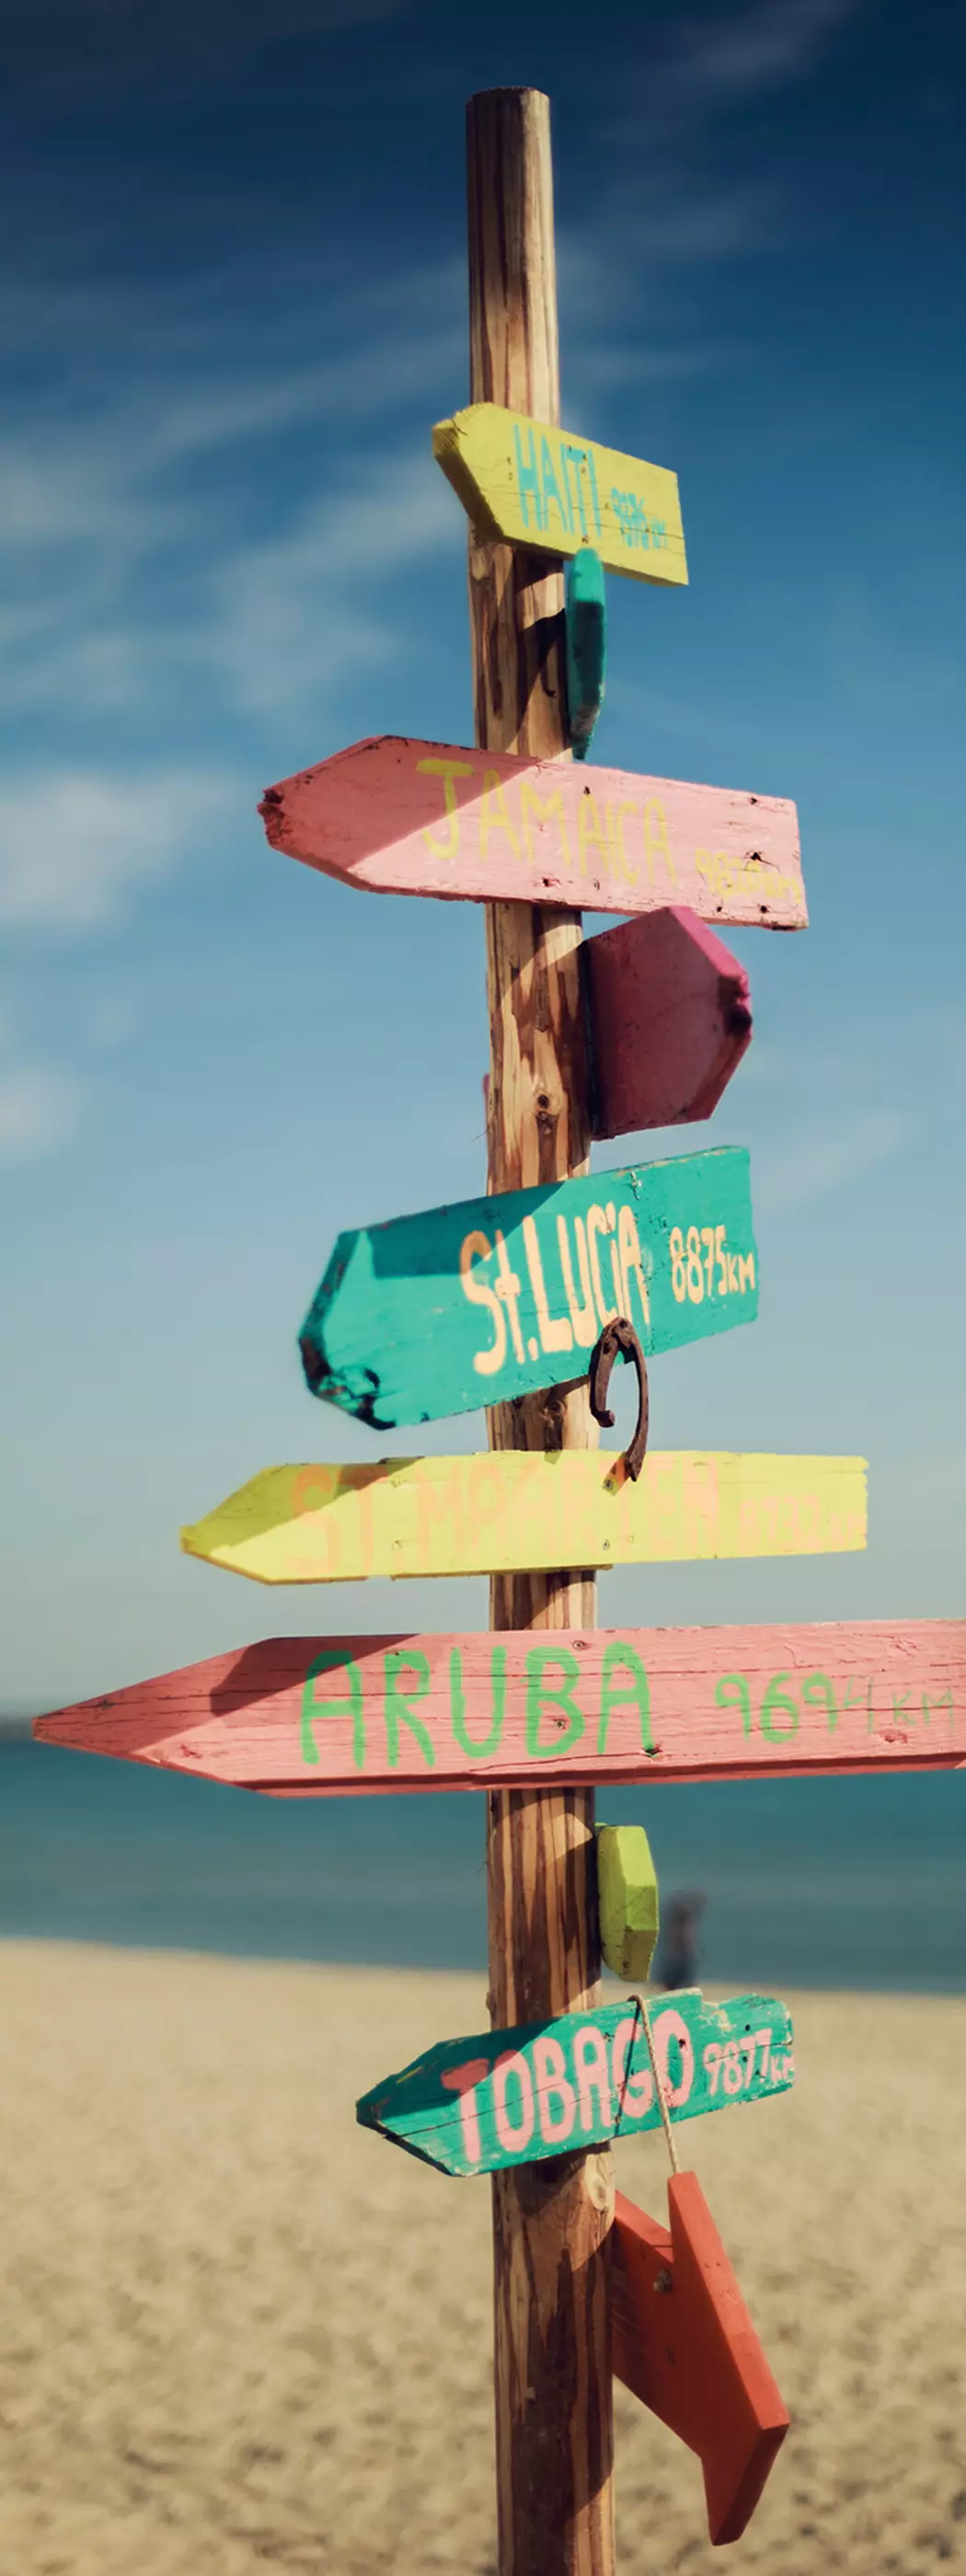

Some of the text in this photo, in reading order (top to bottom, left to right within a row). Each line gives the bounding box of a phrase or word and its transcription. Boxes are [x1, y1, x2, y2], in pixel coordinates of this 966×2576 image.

[512, 423, 602, 538] HAITI
[416, 758, 676, 887] JAMAICA
[414, 1457, 720, 1570] MAARTEN
[300, 1640, 955, 1768] ARUBA 9694 KM
[441, 2008, 695, 2164] TOBAGO
